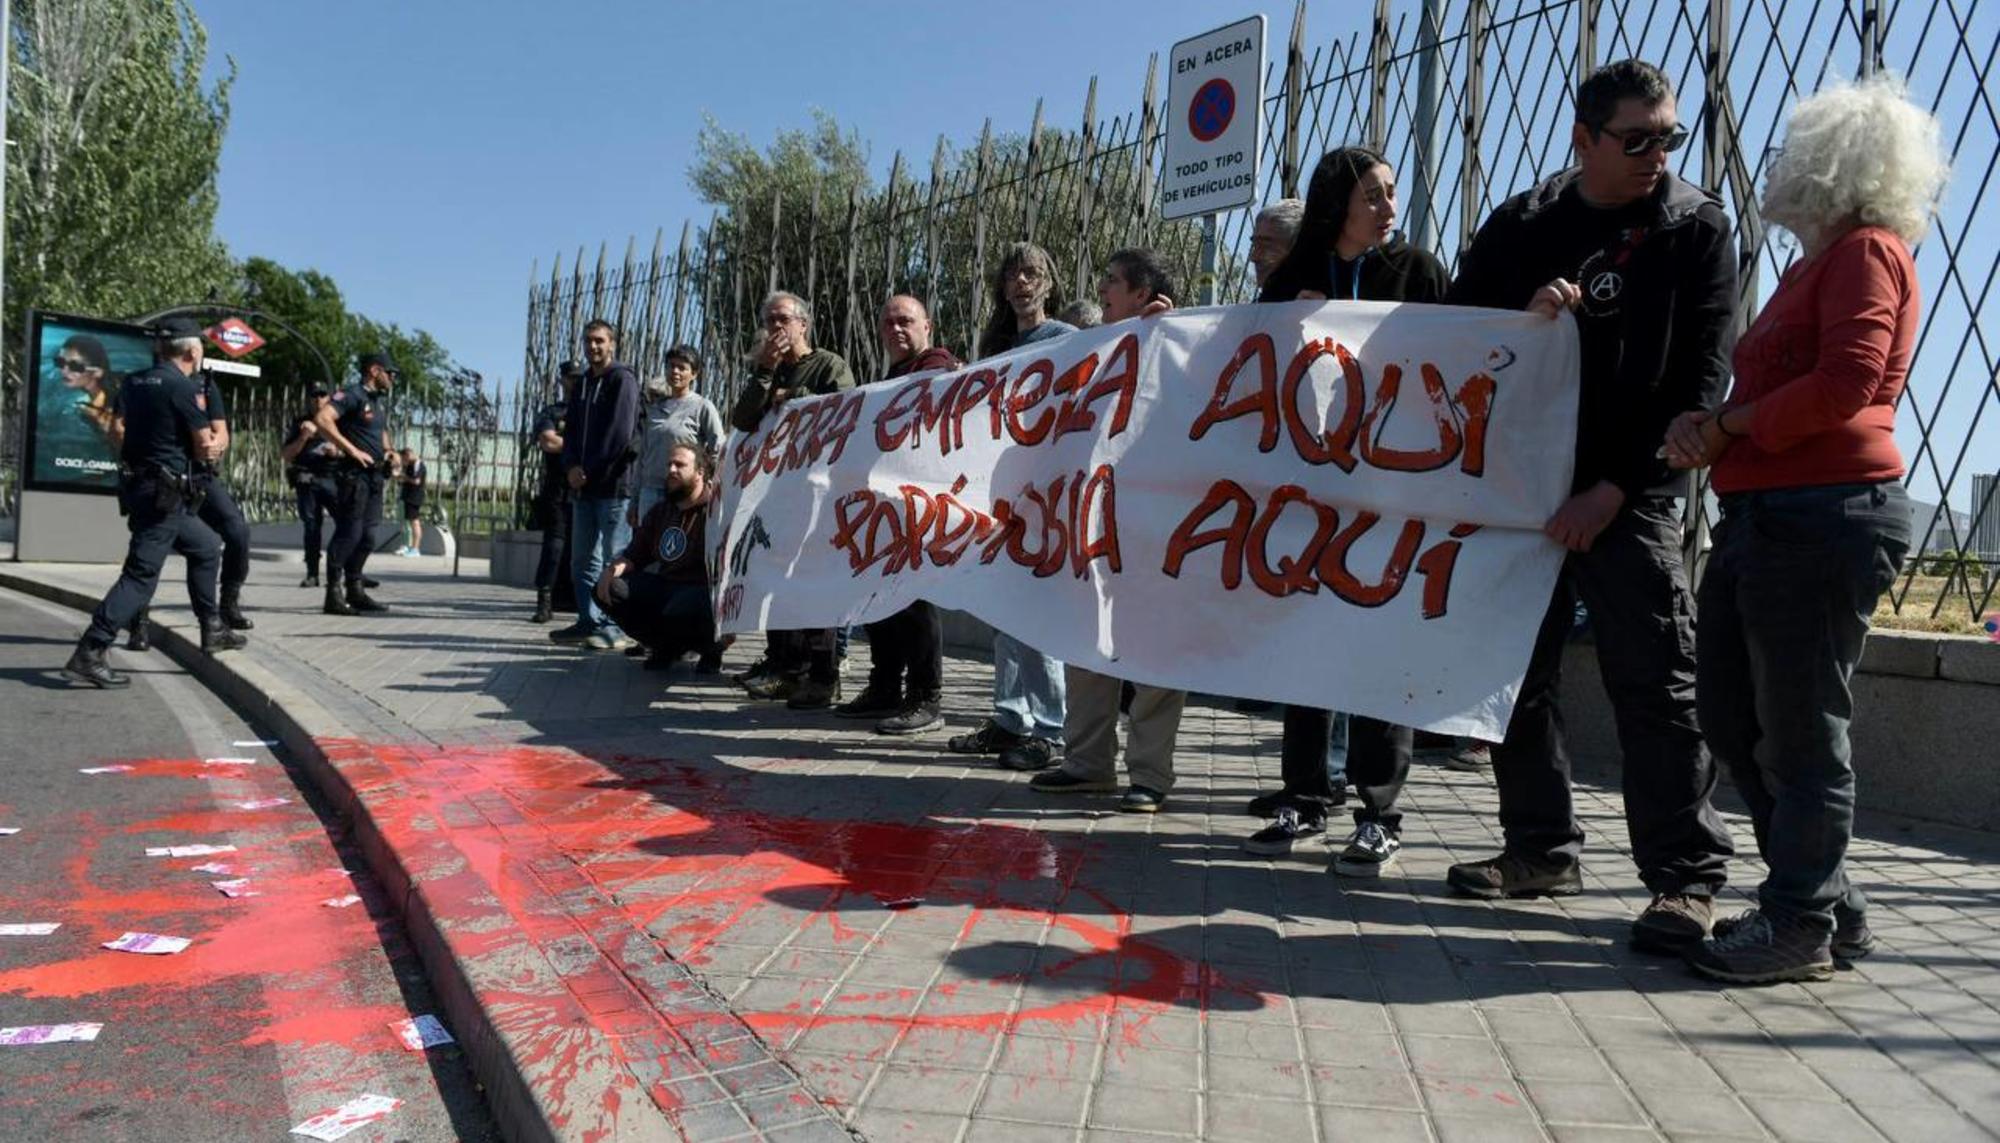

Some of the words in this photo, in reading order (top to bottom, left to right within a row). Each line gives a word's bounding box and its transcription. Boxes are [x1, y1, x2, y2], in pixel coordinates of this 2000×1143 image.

[1177, 57, 1196, 74] EN
[1204, 37, 1253, 65] ACERA
[1175, 159, 1209, 178] TODO
[1215, 151, 1243, 169] TIPO
[1164, 188, 1179, 203] DE
[1182, 172, 1252, 200] VEHÍCULOS
[872, 333, 1139, 457] EMPIEZA
[1189, 332, 1516, 478] AQUÍ
[1162, 478, 1484, 620] AQUÍ
